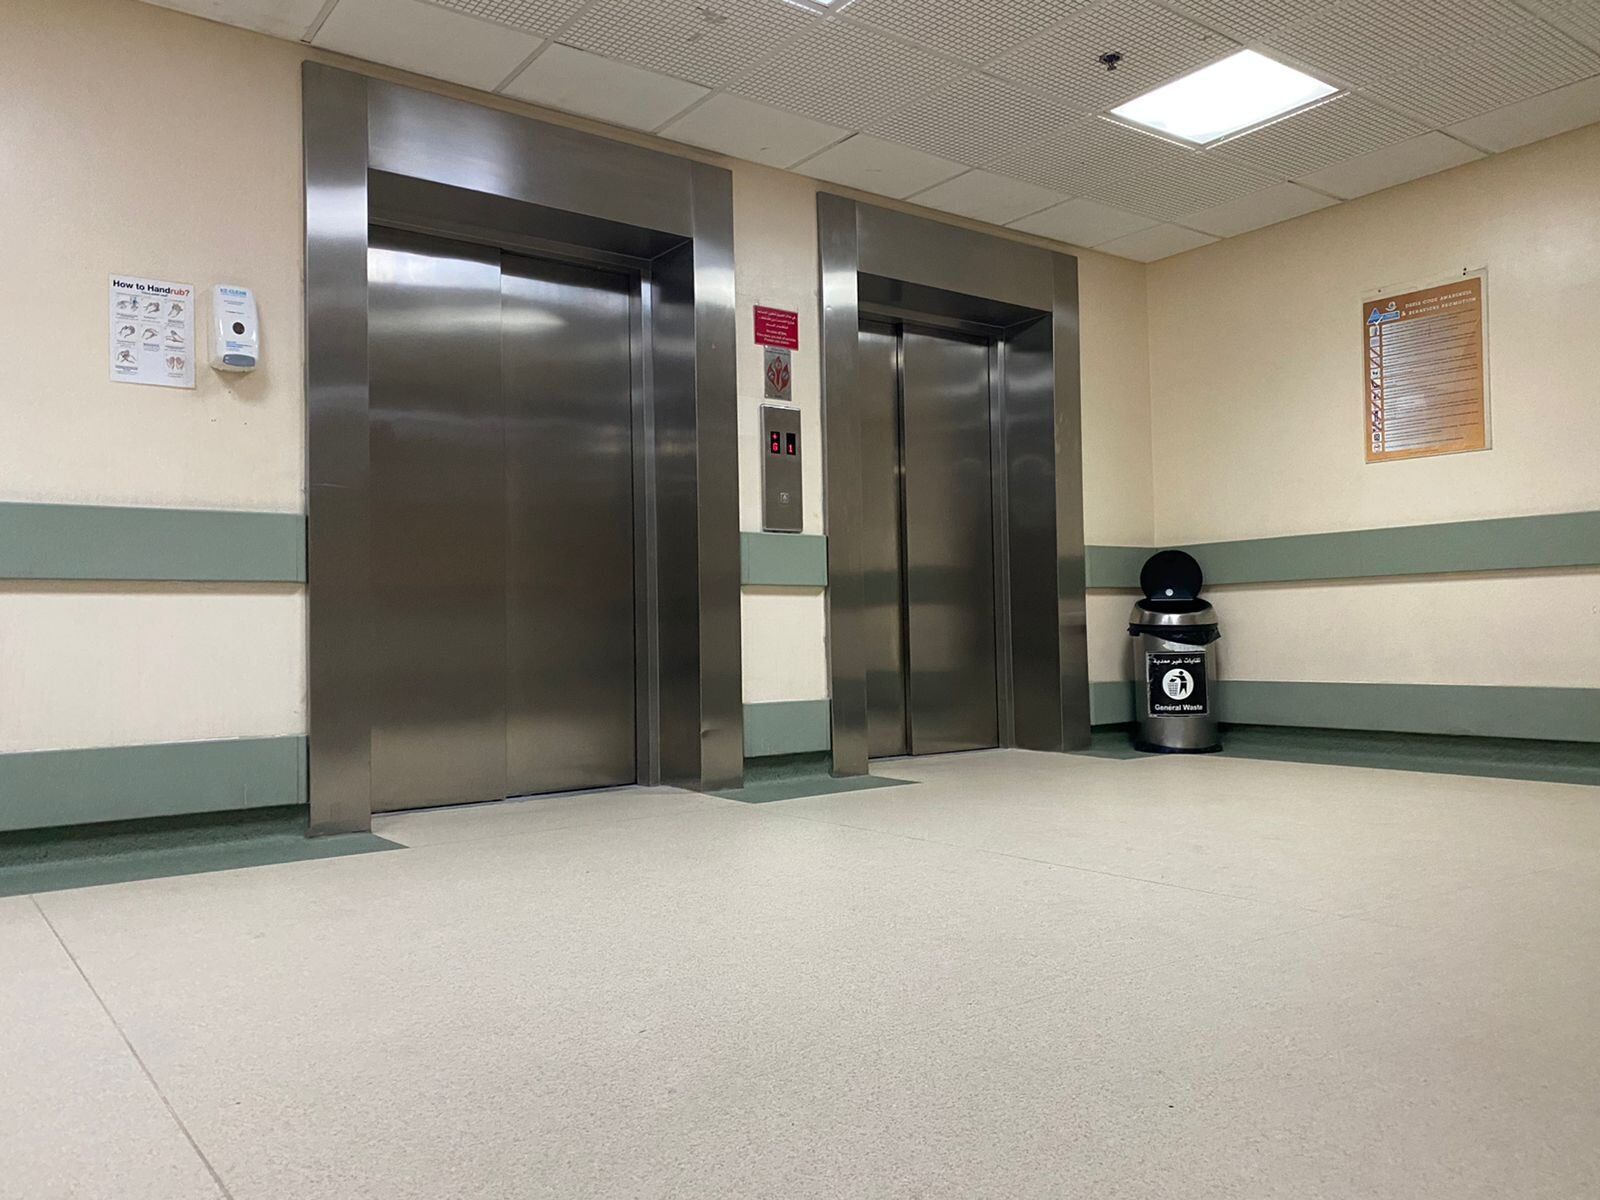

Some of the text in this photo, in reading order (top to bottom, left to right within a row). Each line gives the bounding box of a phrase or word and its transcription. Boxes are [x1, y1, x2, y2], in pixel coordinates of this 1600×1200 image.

[113, 279, 134, 289] How
[135, 283, 145, 291] to
[147, 284, 190, 297] Handrub?
[1154, 703, 1204, 711] General Waste
